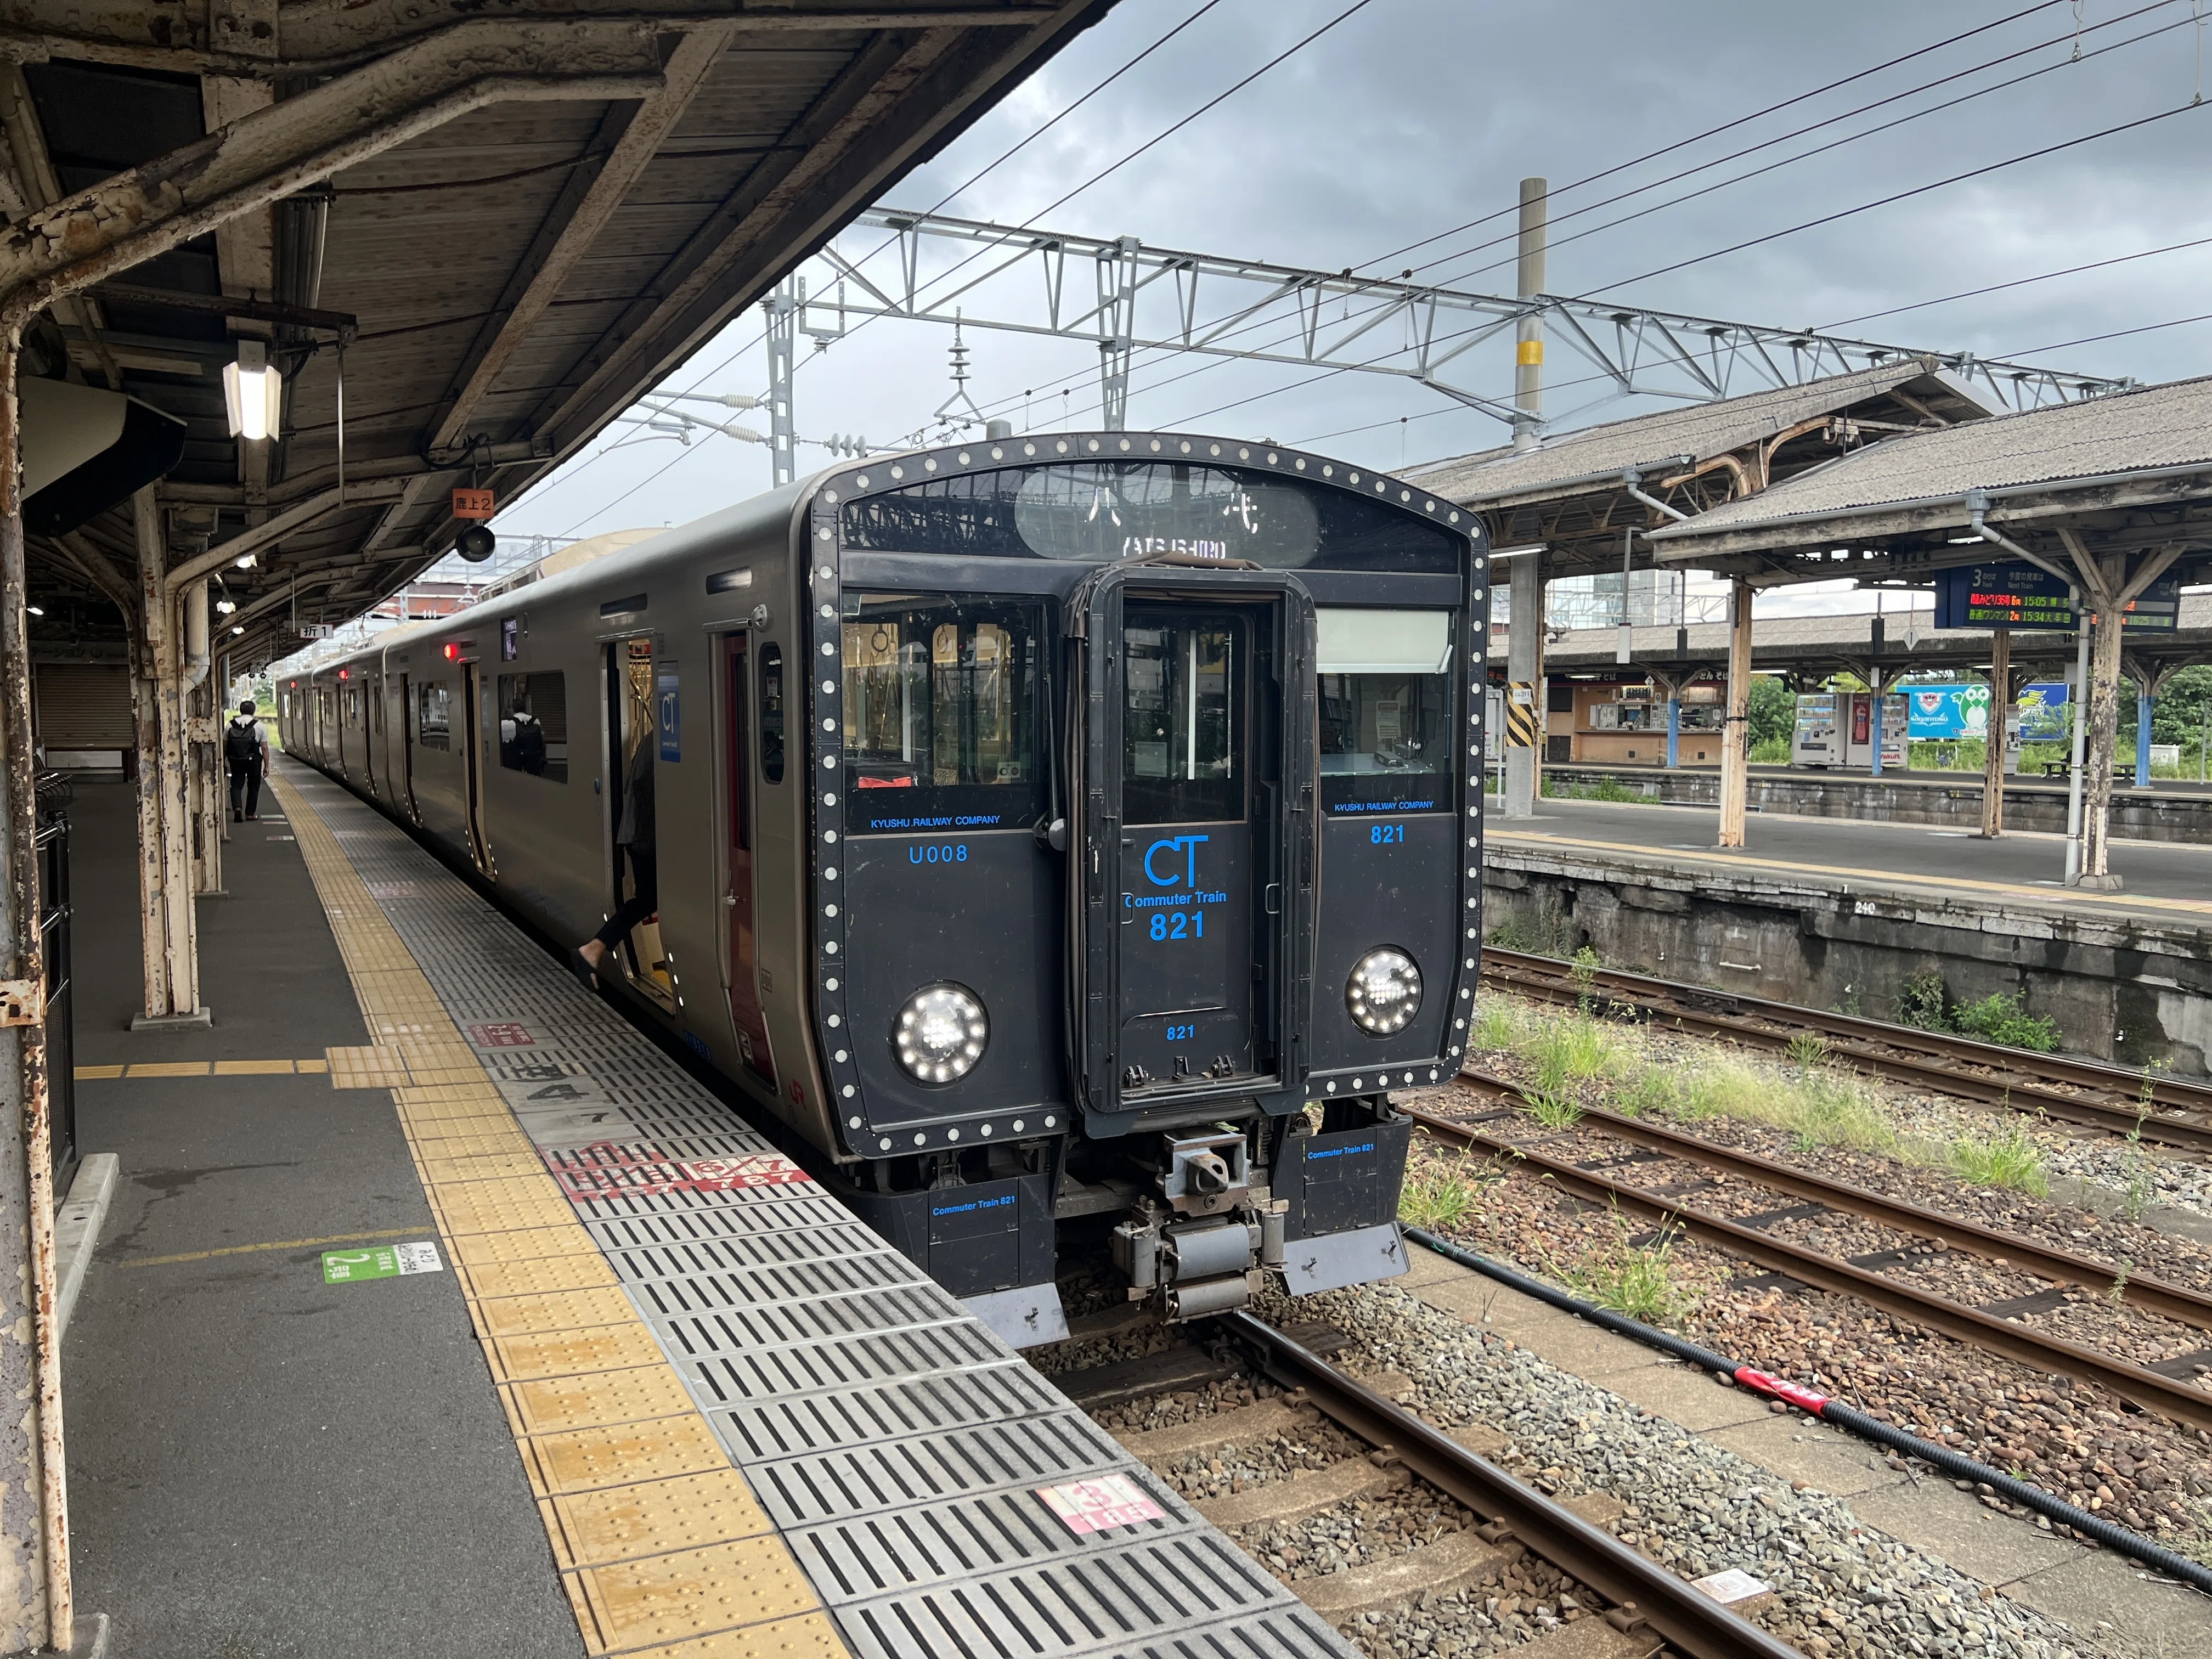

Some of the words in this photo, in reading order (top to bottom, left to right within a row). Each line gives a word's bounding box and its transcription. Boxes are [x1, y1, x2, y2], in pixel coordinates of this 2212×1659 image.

[456, 497, 491, 511] 鹿上2
[1972, 568, 1982, 587] 3
[2008, 581, 2021, 589] Next
[2021, 582, 2034, 590] Train
[2170, 580, 2178, 596] 4
[2024, 596, 2046, 607] 15:05
[2022, 611, 2044, 622] 15:34
[1910, 631, 1913, 645] 1
[1334, 803, 1365, 812] KYUSHU
[1366, 802, 1397, 811] RAILWAY
[1398, 800, 1434, 810] COMPANY
[871, 818, 910, 829] KYUSHU
[912, 816, 953, 827] RAILWAY
[955, 815, 1001, 826] COMPANY
[1370, 824, 1404, 844] 821
[909, 844, 968, 865] U008
[1144, 834, 1209, 888] CT
[1125, 892, 1192, 909] Commuter
[1195, 890, 1227, 904] Train
[1855, 901, 1875, 915] 240
[1150, 911, 1203, 941] 821
[1166, 1024, 1195, 1041] 821
[1307, 1149, 1343, 1160] Commuter
[1343, 1145, 1361, 1154] Train
[1361, 1143, 1374, 1152] 821
[711, 1171, 794, 1189] 787
[933, 1203, 977, 1216] Commuter
[978, 1198, 999, 1209] Train
[1000, 1195, 1015, 1205] 821
[1073, 1485, 1113, 1508] 3
